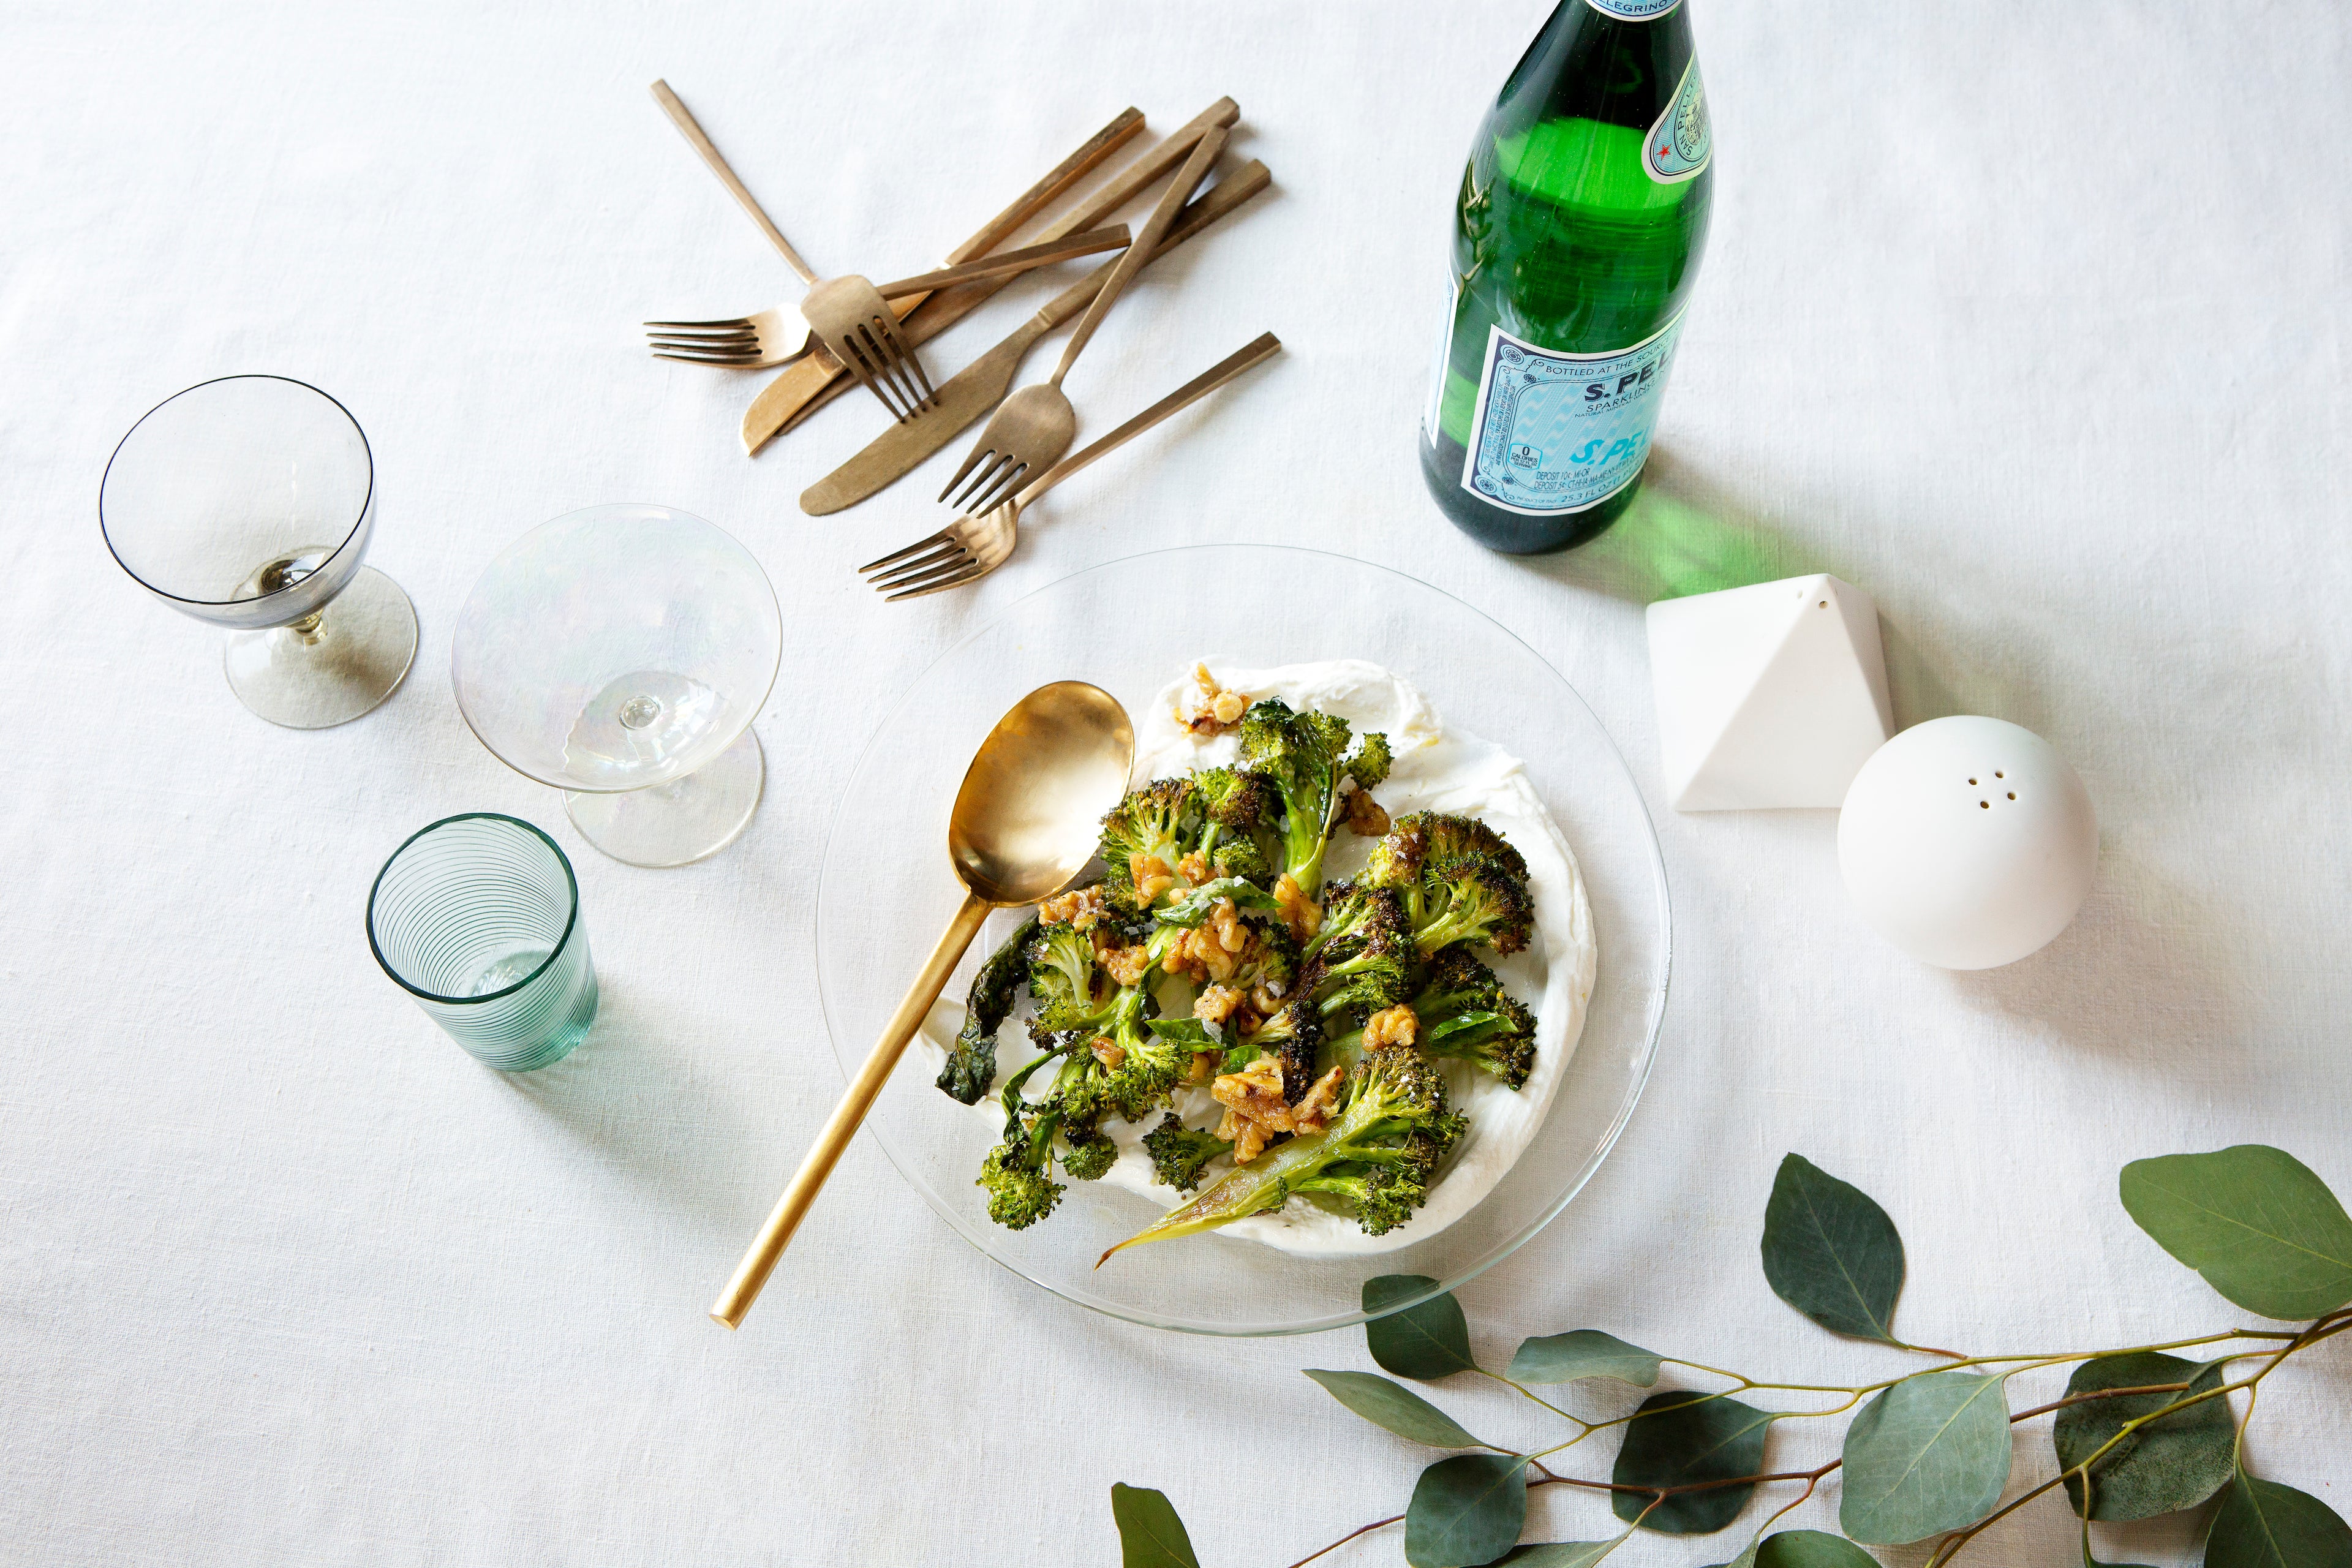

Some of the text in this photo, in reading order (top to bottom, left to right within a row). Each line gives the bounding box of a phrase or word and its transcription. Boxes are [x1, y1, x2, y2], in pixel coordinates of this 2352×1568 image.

[1599, 0, 1667, 12] LEGRINO
[1679, 136, 1693, 156] SAN
[1546, 366, 1594, 376] BOTTLED
[1597, 366, 1611, 375] AT
[1616, 361, 1634, 371] THE
[1586, 377, 1654, 412] SPARKLING
[1606, 399, 1631, 412] MINERAL
[1512, 453, 1538, 462] CALORIES
[1522, 447, 1530, 456] 0
[1536, 471, 1560, 480] DEPOSIT
[1534, 481, 1558, 490] DEPOSIT
[1561, 493, 1583, 502] 25.3
[1586, 489, 1596, 498] FL
[1598, 481, 1612, 492] OZ
